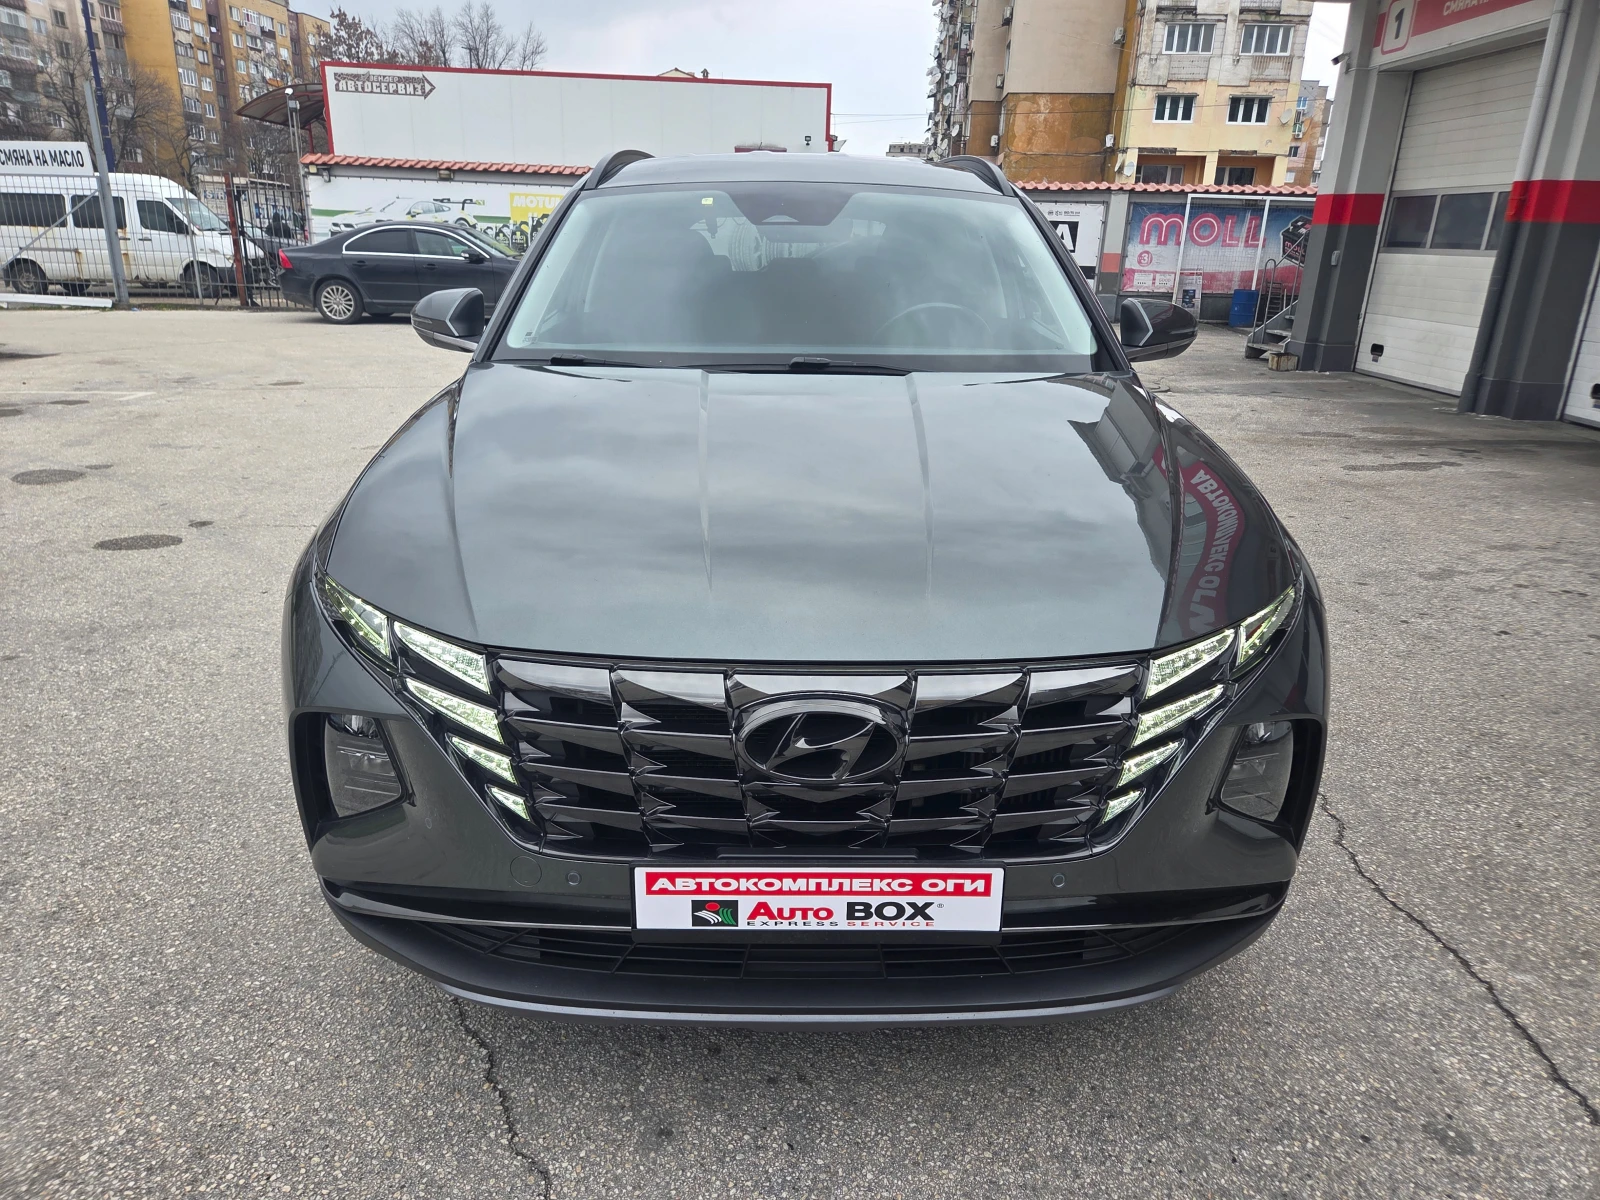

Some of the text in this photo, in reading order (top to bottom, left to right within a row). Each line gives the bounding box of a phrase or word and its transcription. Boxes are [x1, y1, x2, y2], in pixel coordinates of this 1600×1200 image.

[1394, 8, 1405, 40] 1
[338, 80, 422, 95] АВТОСЕРВИЗ
[0, 148, 84, 168] СМЯНА НА МАСЛО
[1138, 212, 1267, 248] MOLL
[650, 877, 986, 893] АВТОКОМПЛЕКС ОГИ
